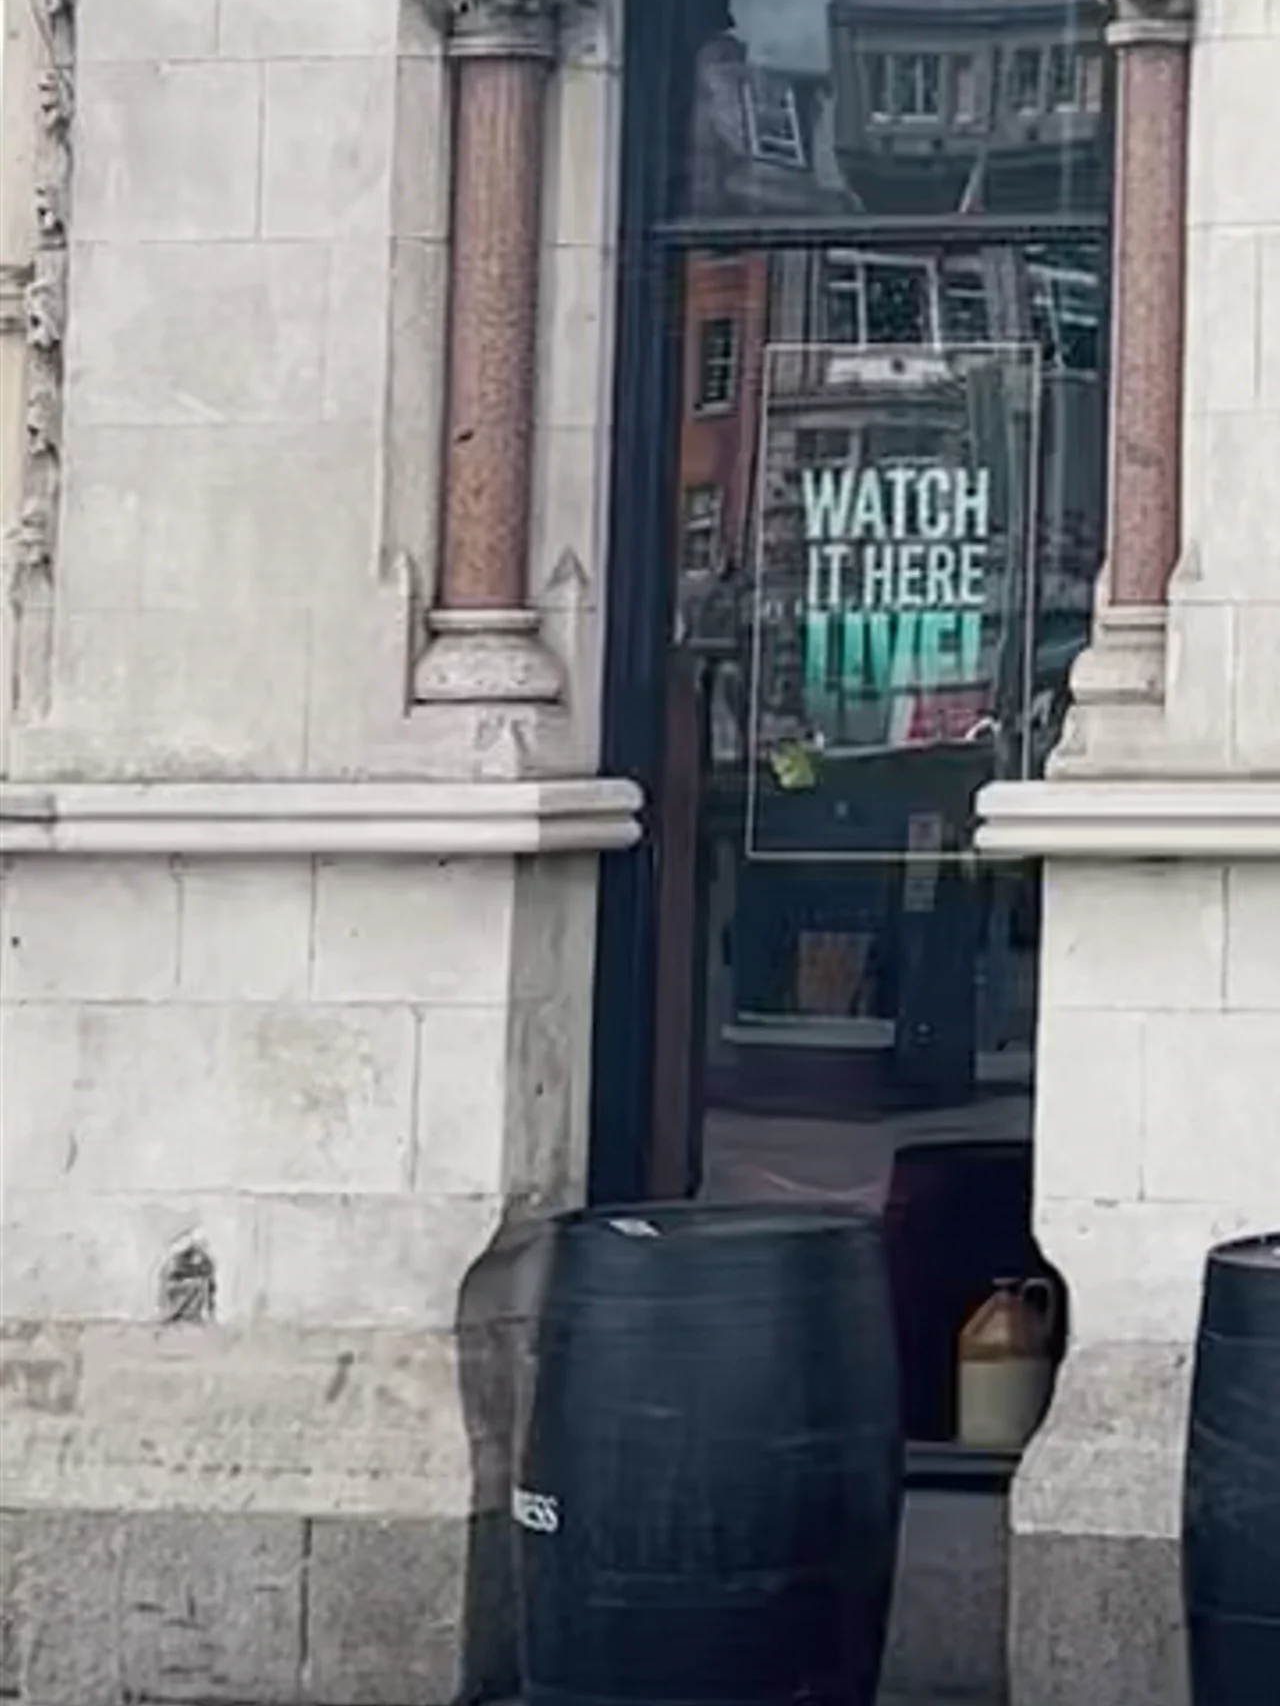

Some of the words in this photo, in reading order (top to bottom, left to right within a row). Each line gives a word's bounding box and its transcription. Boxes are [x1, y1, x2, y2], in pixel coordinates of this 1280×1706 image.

[803, 466, 990, 539] WATCH
[808, 543, 851, 606] IT
[863, 543, 989, 606] HERE
